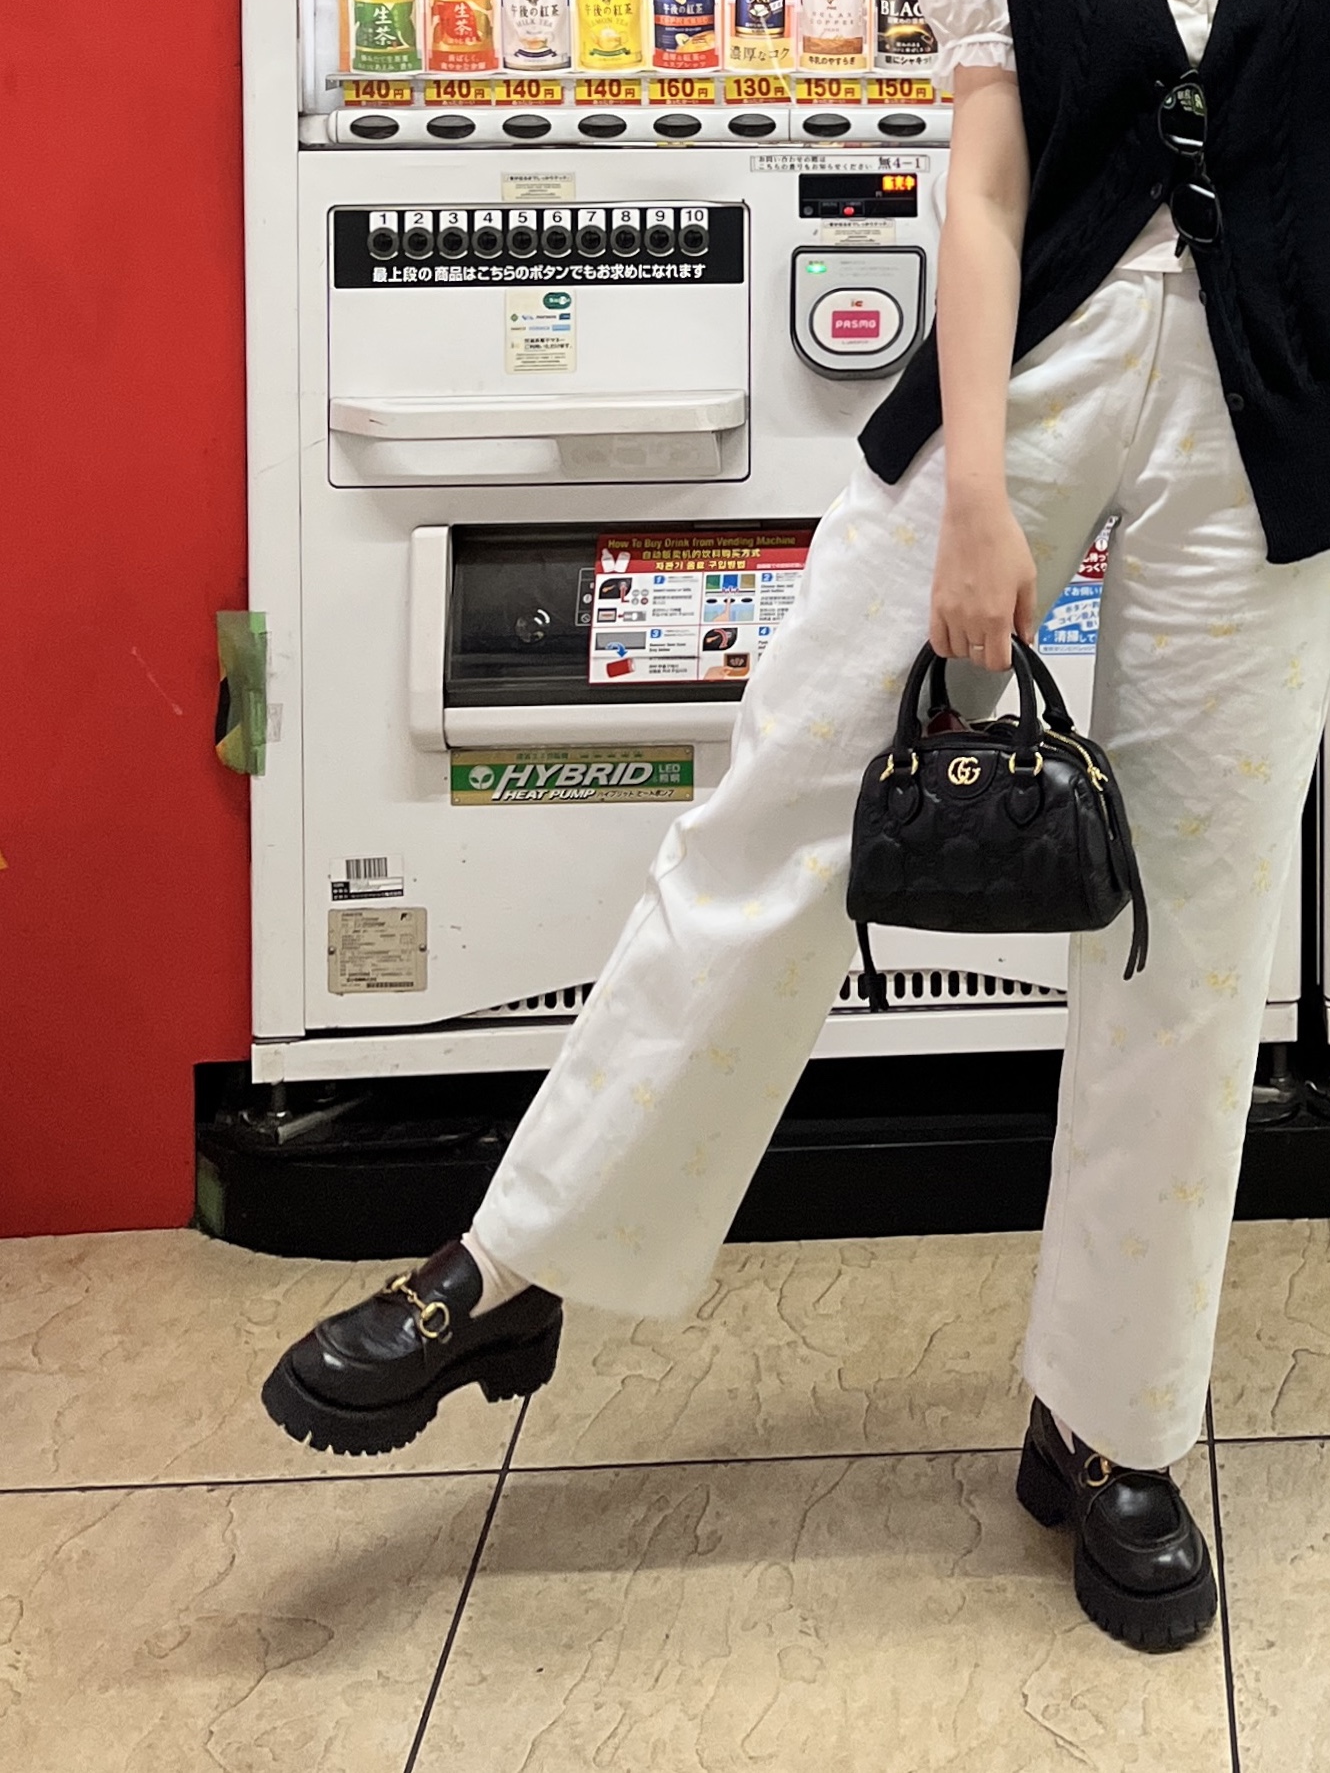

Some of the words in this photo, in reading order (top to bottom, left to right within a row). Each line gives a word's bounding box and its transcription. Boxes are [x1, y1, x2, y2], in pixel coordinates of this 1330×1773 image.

[511, 4, 560, 17] 午後の紅茶
[585, 4, 632, 16] 午後の紅茶
[663, 4, 702, 15] 午後の紅茶
[455, 3, 472, 34] 生茶
[374, 6, 396, 45] 生茶
[731, 47, 790, 61] 濃厚なコク
[379, 211, 388, 224] 1
[413, 211, 423, 224] 2
[448, 211, 458, 224] 3
[483, 211, 493, 224] 4
[517, 211, 528, 224] 5
[552, 210, 562, 223] 6
[587, 210, 596, 223] 7
[621, 210, 631, 223] 8
[655, 210, 665, 223] 9
[686, 210, 704, 222] 10
[835, 319, 877, 329] PASMO
[608, 540, 629, 549] How
[632, 539, 642, 548] To
[644, 539, 662, 549] Buy
[664, 538, 689, 547] Drink
[692, 538, 715, 547] from
[716, 537, 754, 547] Vending
[756, 536, 796, 546] Machine
[658, 764, 681, 773] LED
[494, 763, 653, 792] HYBRID
[506, 790, 548, 800] HEAT
[549, 789, 596, 800] PUMP
